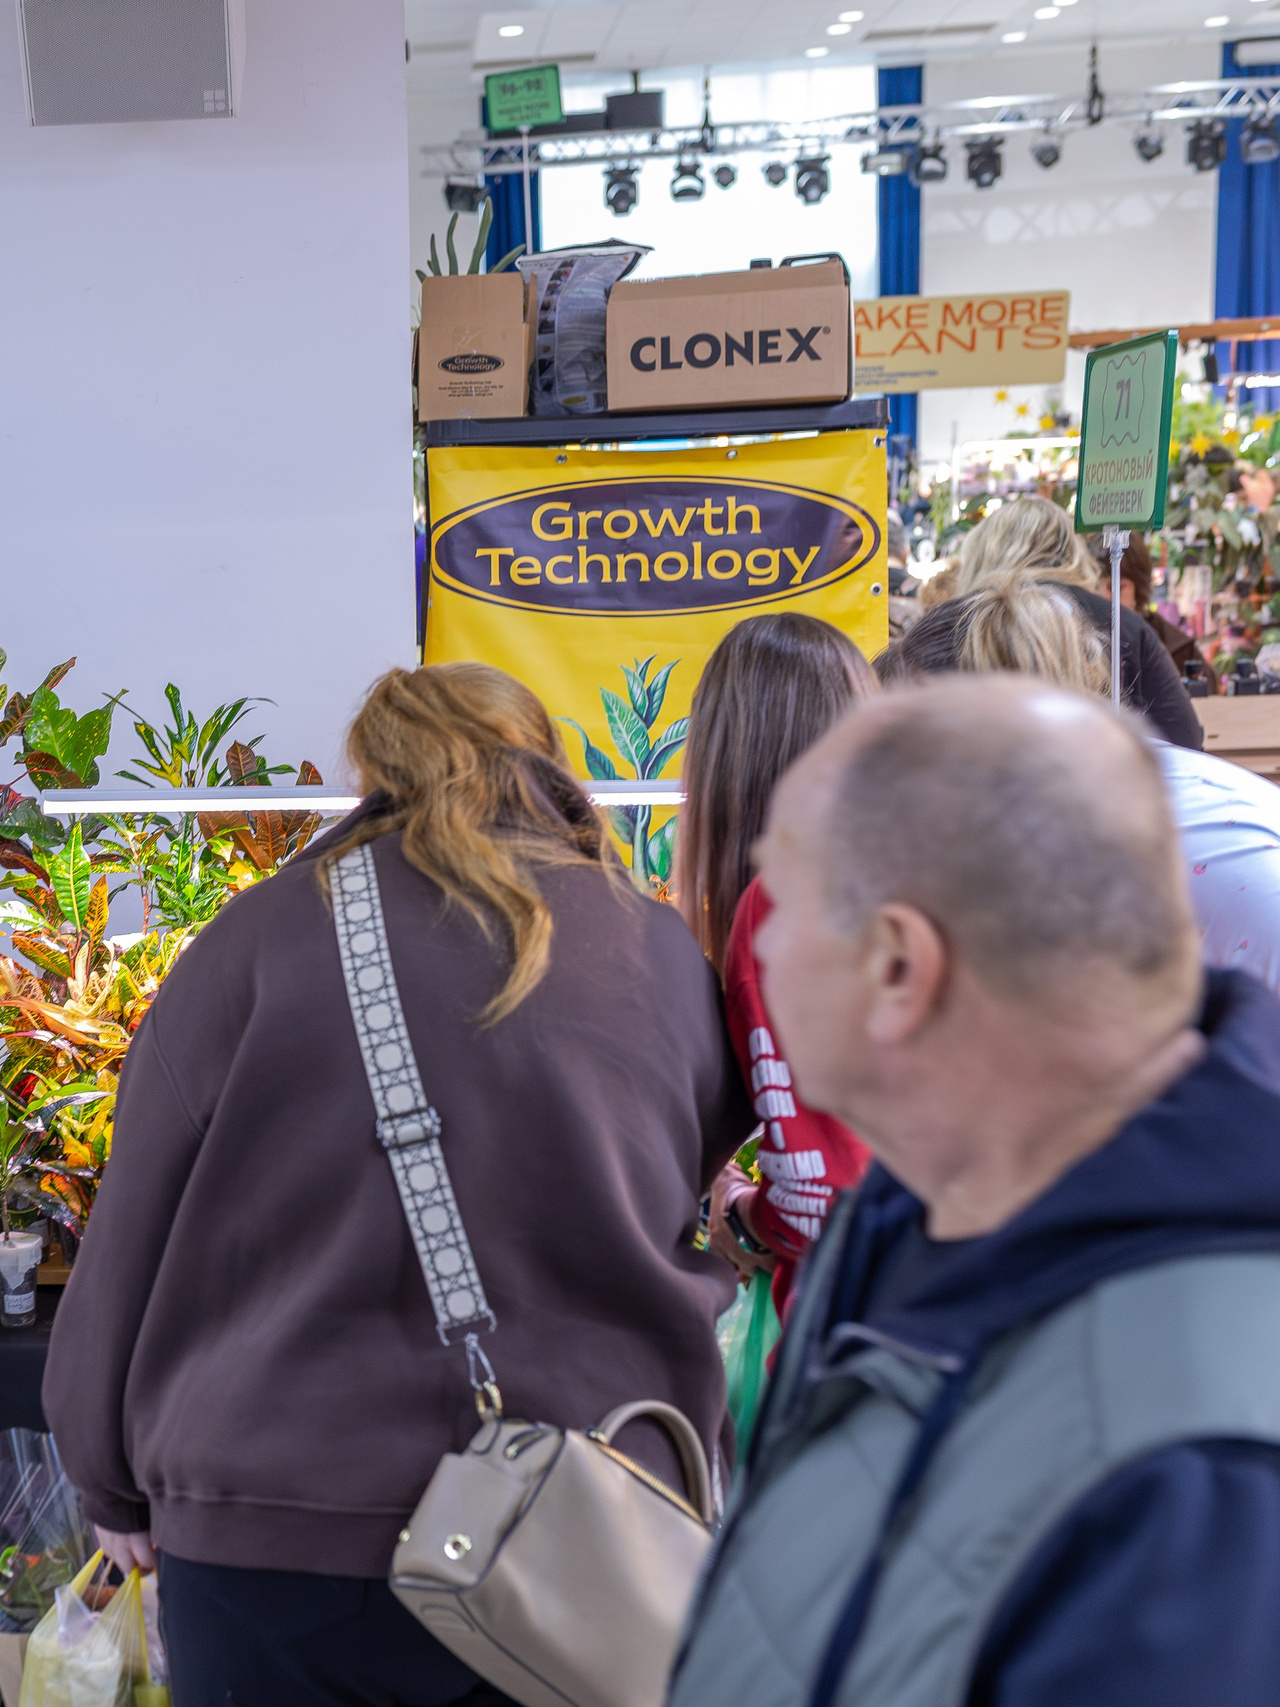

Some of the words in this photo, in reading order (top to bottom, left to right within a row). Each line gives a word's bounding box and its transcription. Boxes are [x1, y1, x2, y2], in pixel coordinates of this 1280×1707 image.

[855, 304, 930, 331] AKE
[943, 297, 1066, 328] MORE
[629, 325, 823, 373] CLONEX
[855, 323, 1063, 359] LANTS
[446, 362, 497, 372] Technology
[454, 356, 489, 365] Growth
[1114, 377, 1132, 422] 71
[1084, 449, 1154, 487] КРОТОНОВЫЙ
[531, 496, 763, 542] Growth
[1088, 487, 1145, 517] ФЕЙЕРВЕРК
[475, 541, 821, 587] Technology
